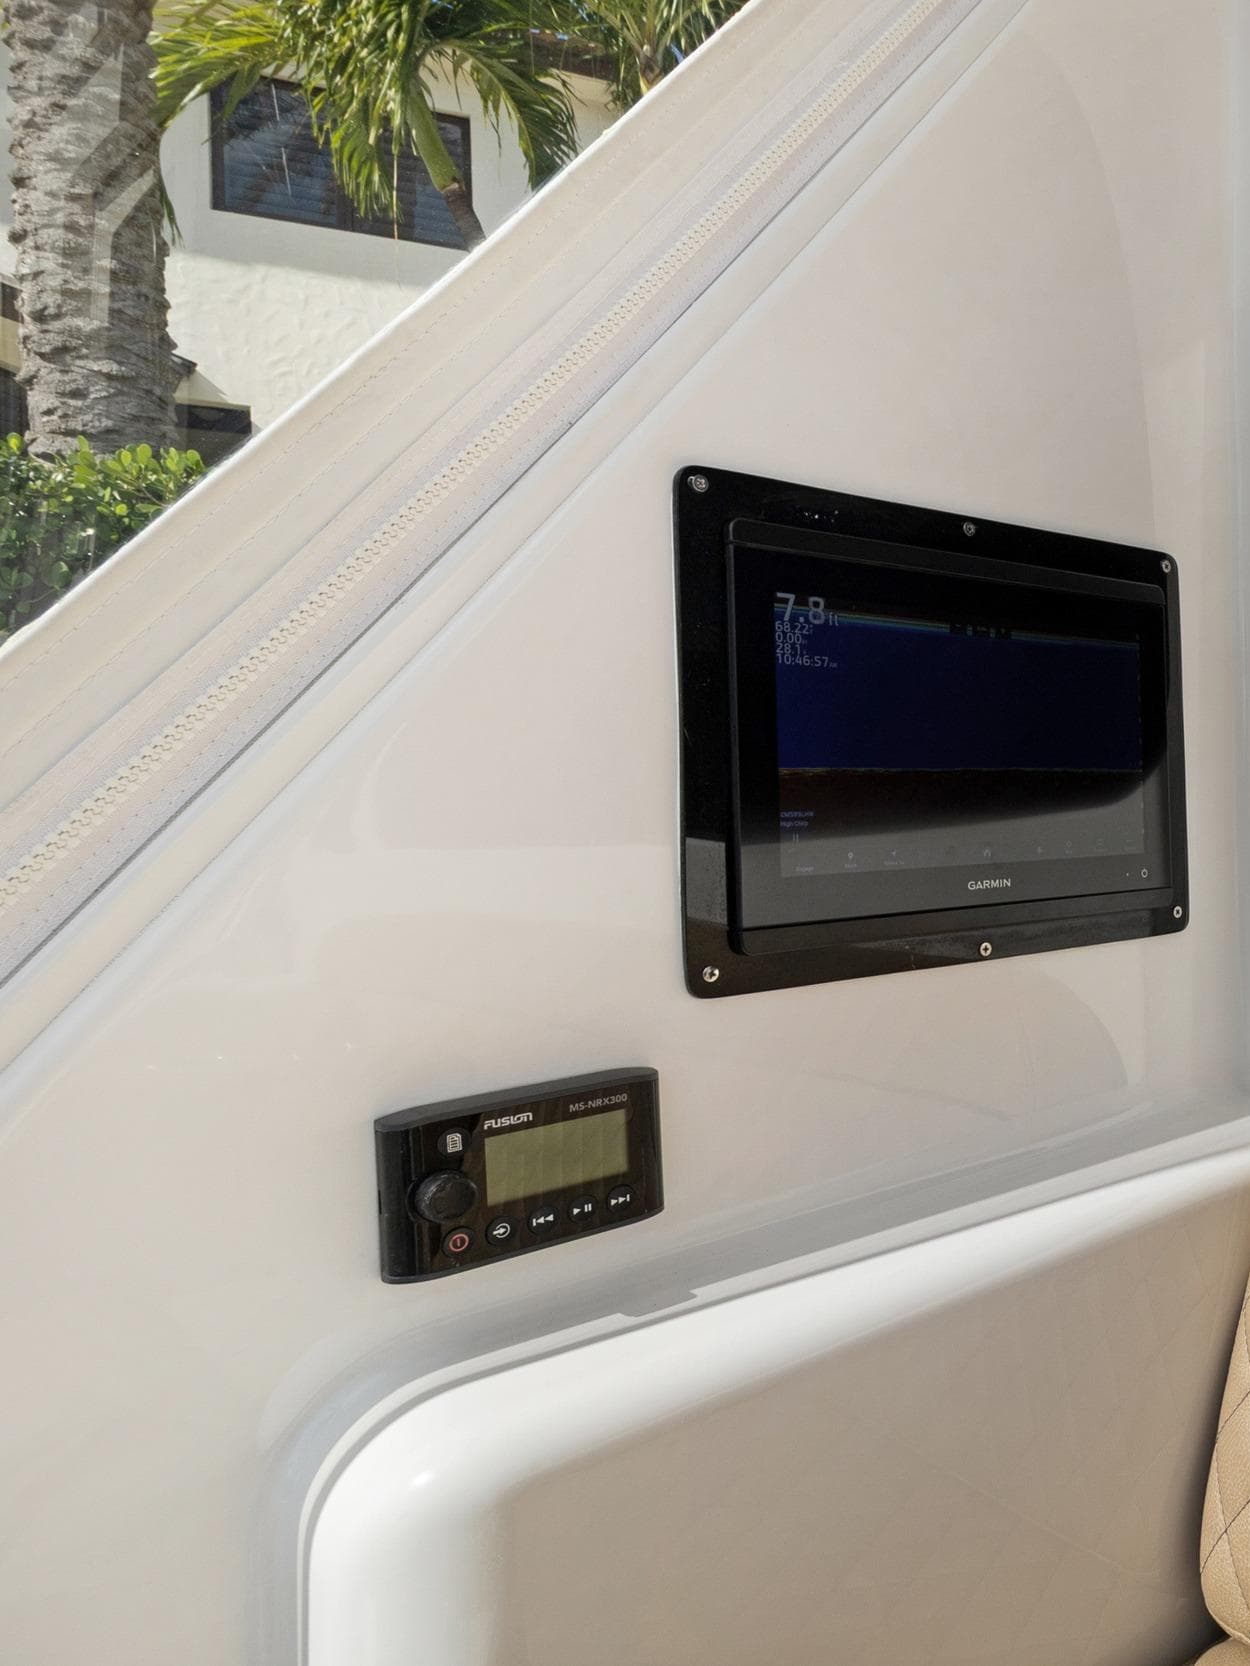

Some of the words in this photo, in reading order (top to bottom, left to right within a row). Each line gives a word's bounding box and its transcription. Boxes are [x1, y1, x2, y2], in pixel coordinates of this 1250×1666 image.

[776, 592, 825, 624] 7.8
[968, 878, 1012, 891] GARMIN
[569, 1093, 628, 1113] MS-NRX300
[484, 1112, 533, 1130] FUSION
